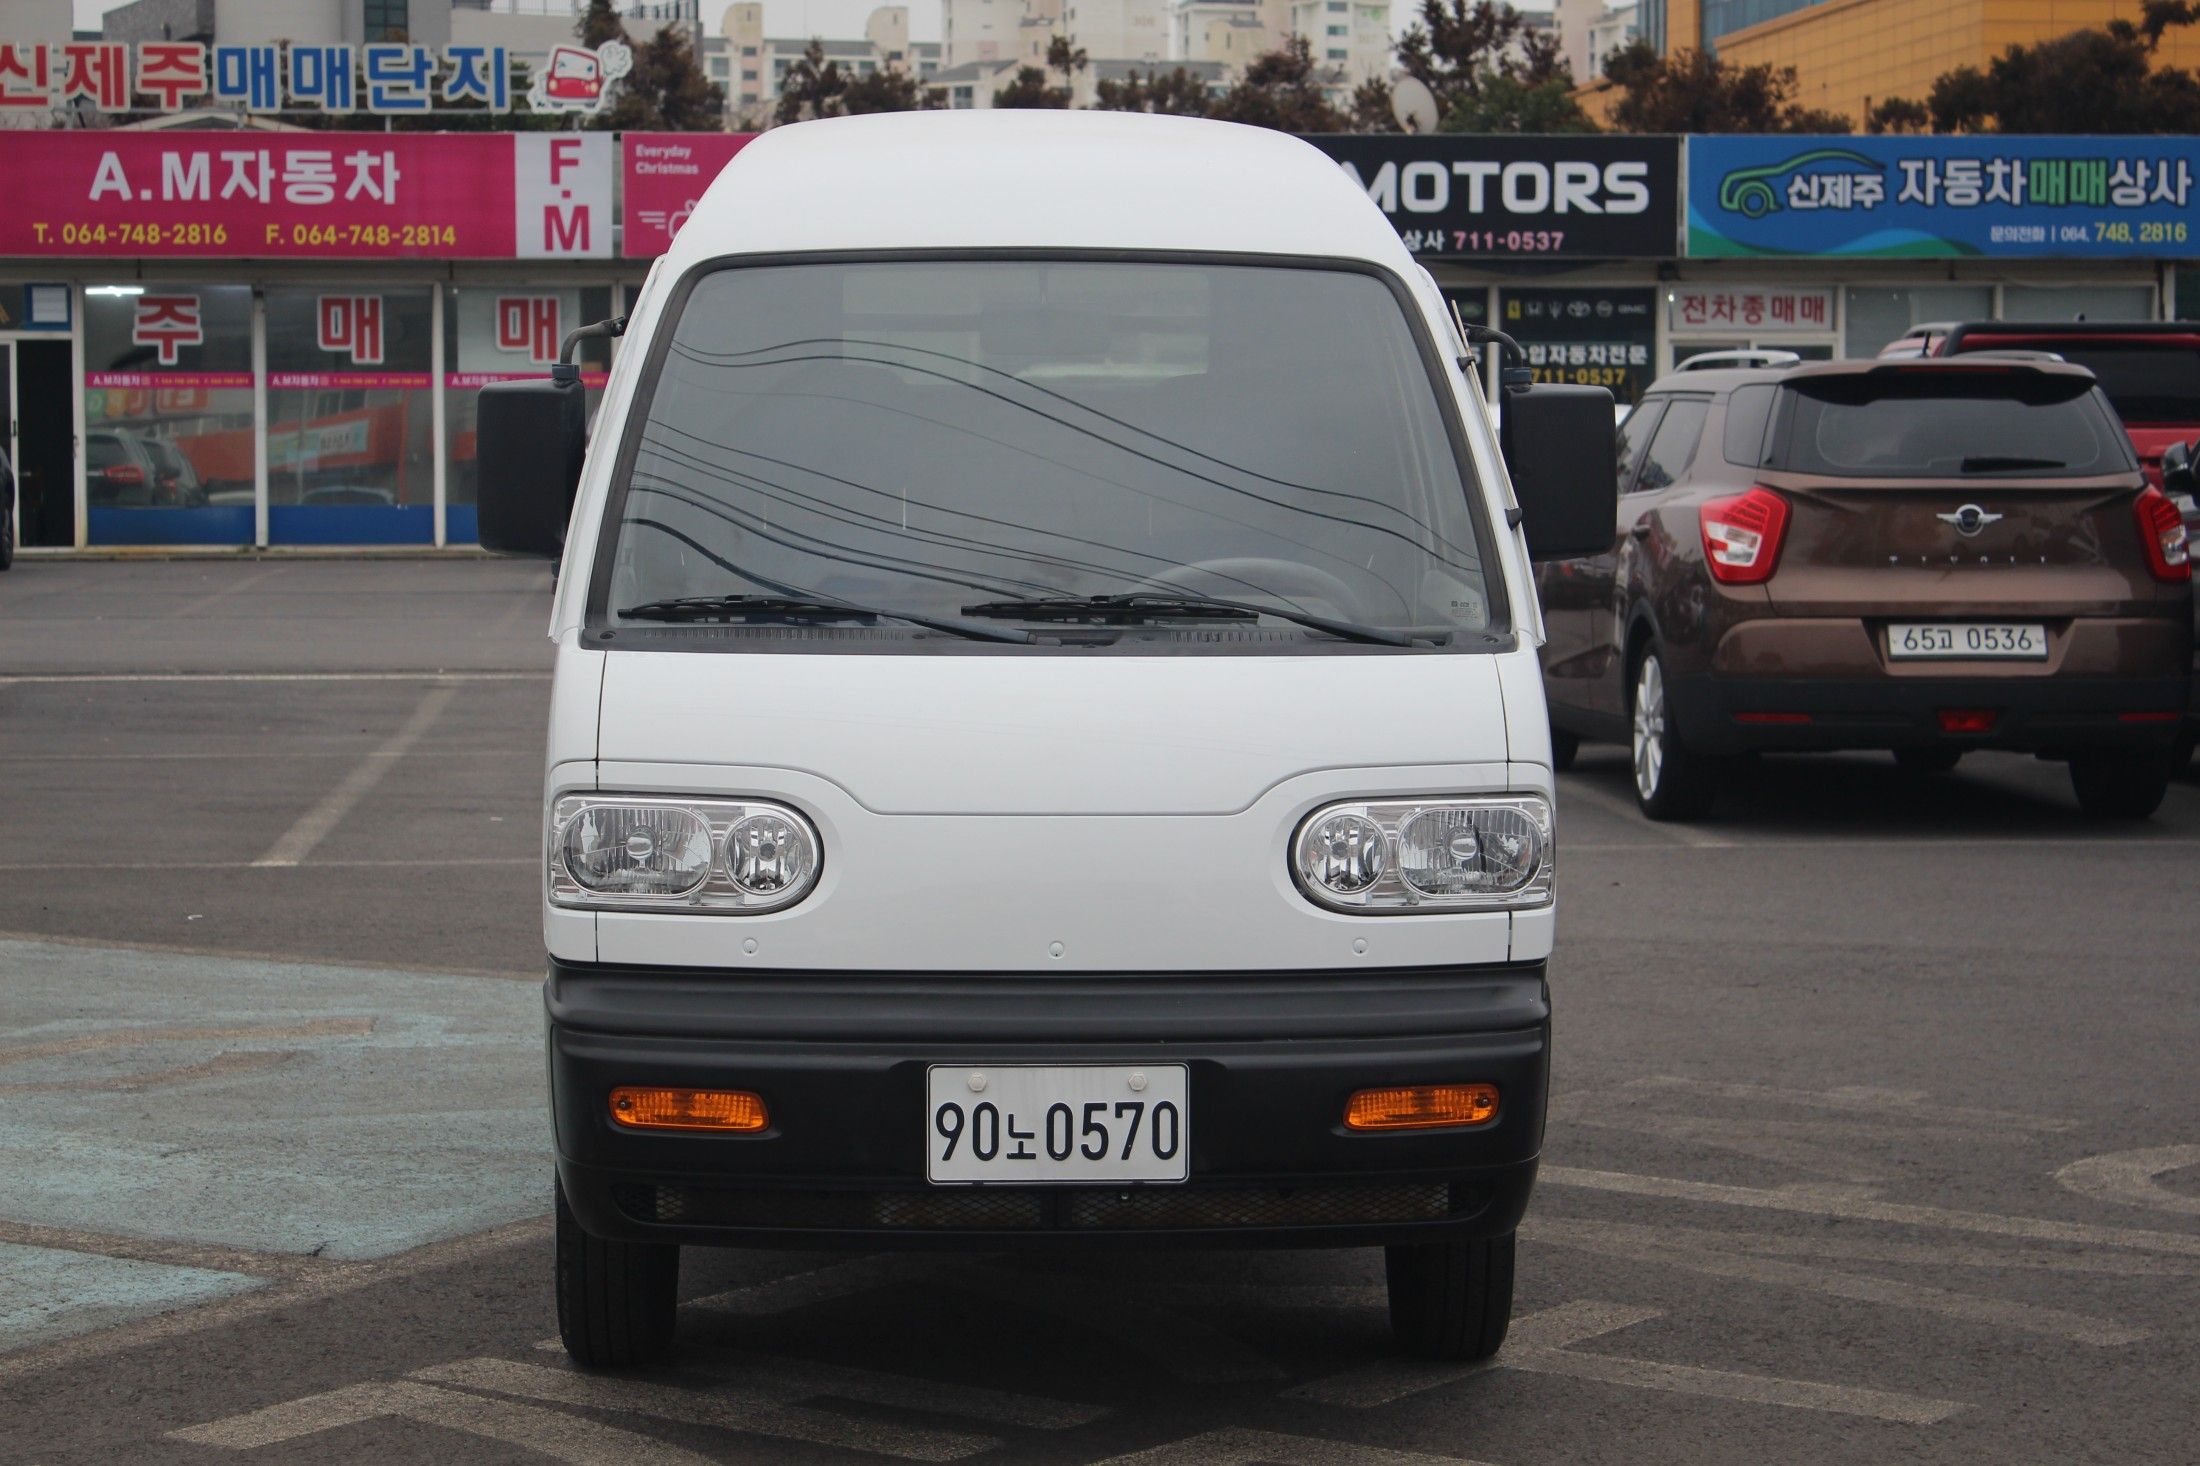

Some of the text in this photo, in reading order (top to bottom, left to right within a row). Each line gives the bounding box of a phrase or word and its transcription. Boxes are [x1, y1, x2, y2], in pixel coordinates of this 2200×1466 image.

[635, 144, 692, 160] Everyday
[88, 149, 401, 205] A.M자동차
[635, 161, 699, 176] Christmas
[1787, 173, 1885, 209] 신제주
[33, 222, 227, 245] T. 064-748-2816
[265, 224, 456, 246] F. 064-748-2814
[1453, 231, 1565, 251] 711-0537
[2139, 222, 2187, 243] 2816
[1682, 293, 1826, 325] 전차종매매
[133, 296, 562, 363] 주 매 매
[1508, 345, 1647, 365] 입자동차전문
[1531, 368, 1626, 385] 711-0537
[1966, 628, 2032, 650] 0536
[935, 1100, 1179, 1162] 90노0570
